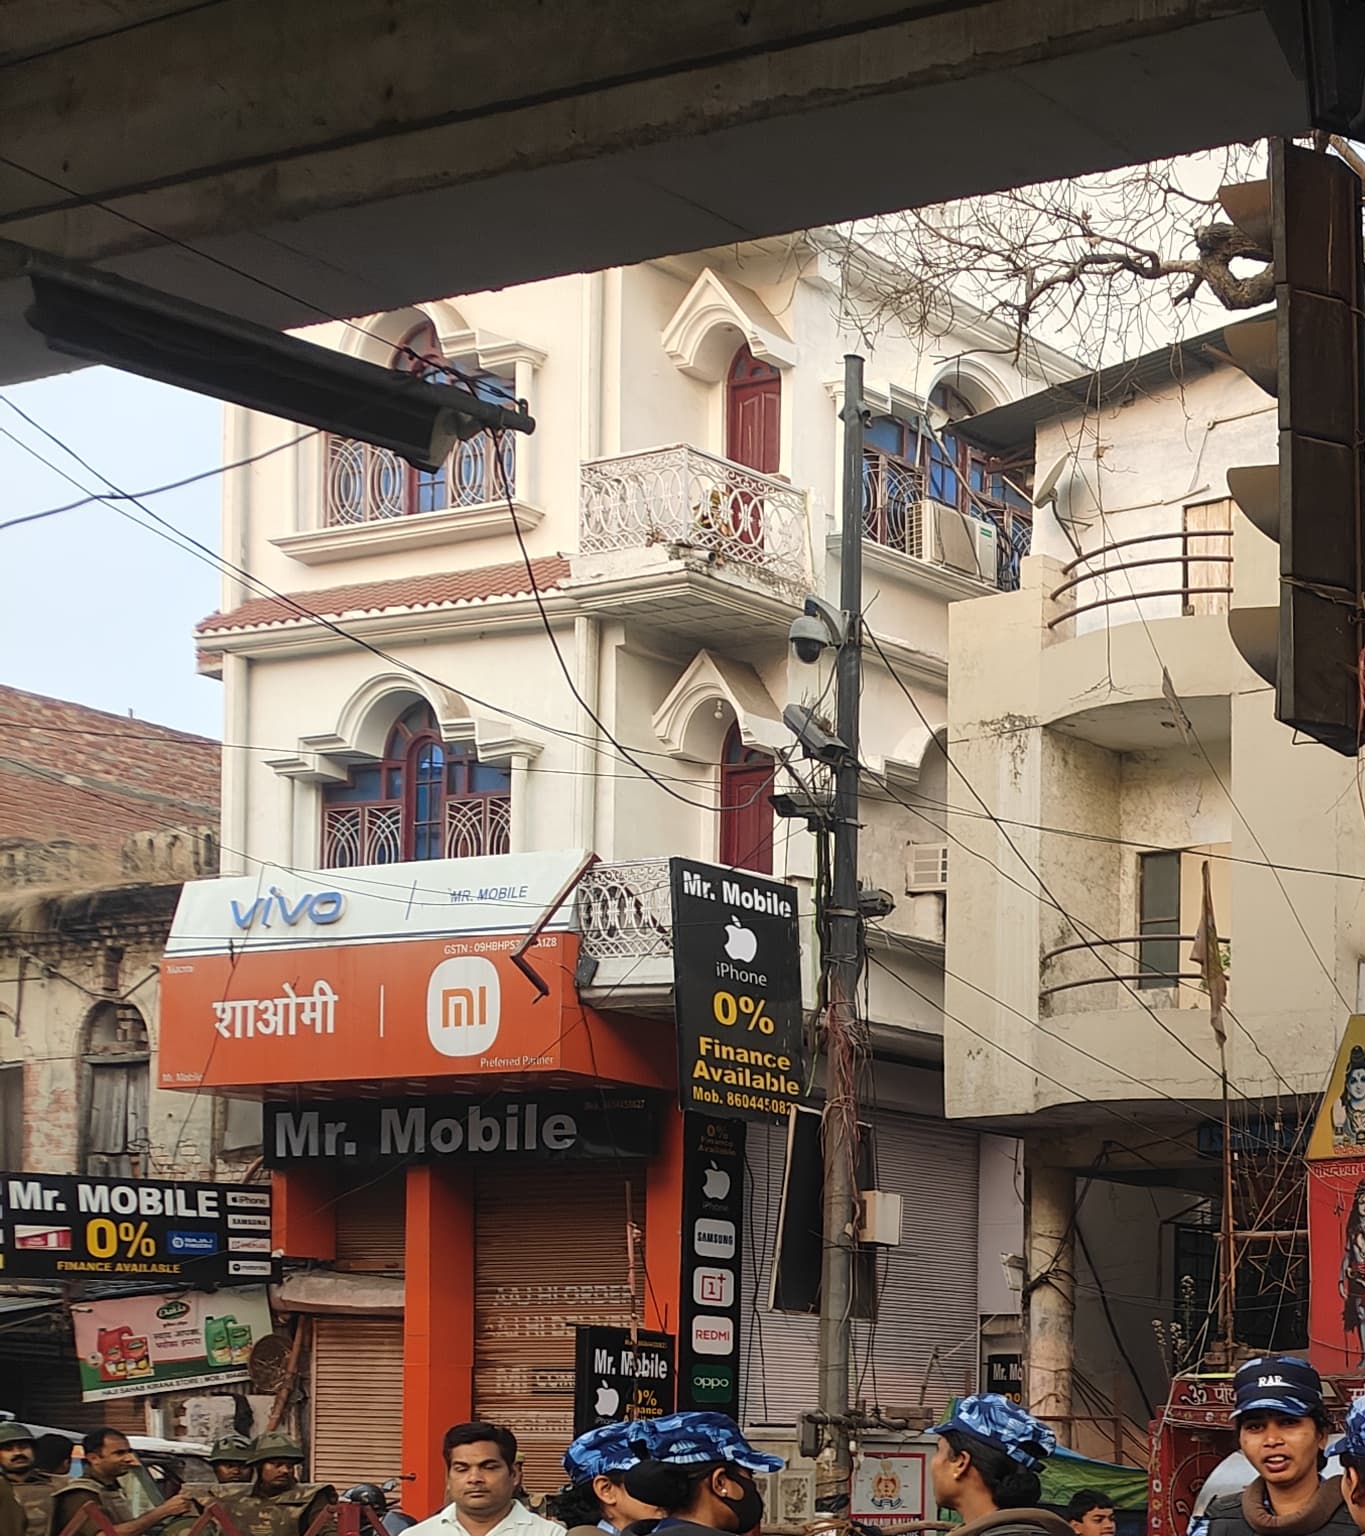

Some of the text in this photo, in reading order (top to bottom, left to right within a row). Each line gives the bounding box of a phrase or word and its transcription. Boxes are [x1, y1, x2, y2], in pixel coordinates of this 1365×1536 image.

[230, 884, 529, 931] vivo MR. MOBILE
[683, 869, 793, 920] Mr. Mobile
[444, 943, 467, 956] GSTN
[715, 962, 769, 987] iPhone
[212, 978, 339, 1040] शाओमी
[712, 991, 776, 1036] 0%
[480, 1053, 555, 1069] Preferred Partner
[699, 1036, 792, 1073] Finance
[691, 1059, 801, 1097] Available
[693, 1084, 724, 1107] Mob.
[275, 1102, 579, 1159] Mr. Mobile
[8, 1180, 222, 1219] Mr. MOBILE
[86, 1217, 157, 1260] 0%
[697, 1230, 733, 1247] SAMSUNG
[57, 1260, 112, 1273] FINANCE
[695, 1329, 731, 1342] REDMI
[594, 1347, 617, 1376] Mr.
[693, 1374, 730, 1390] oppo
[1257, 1375, 1284, 1389] RAF
